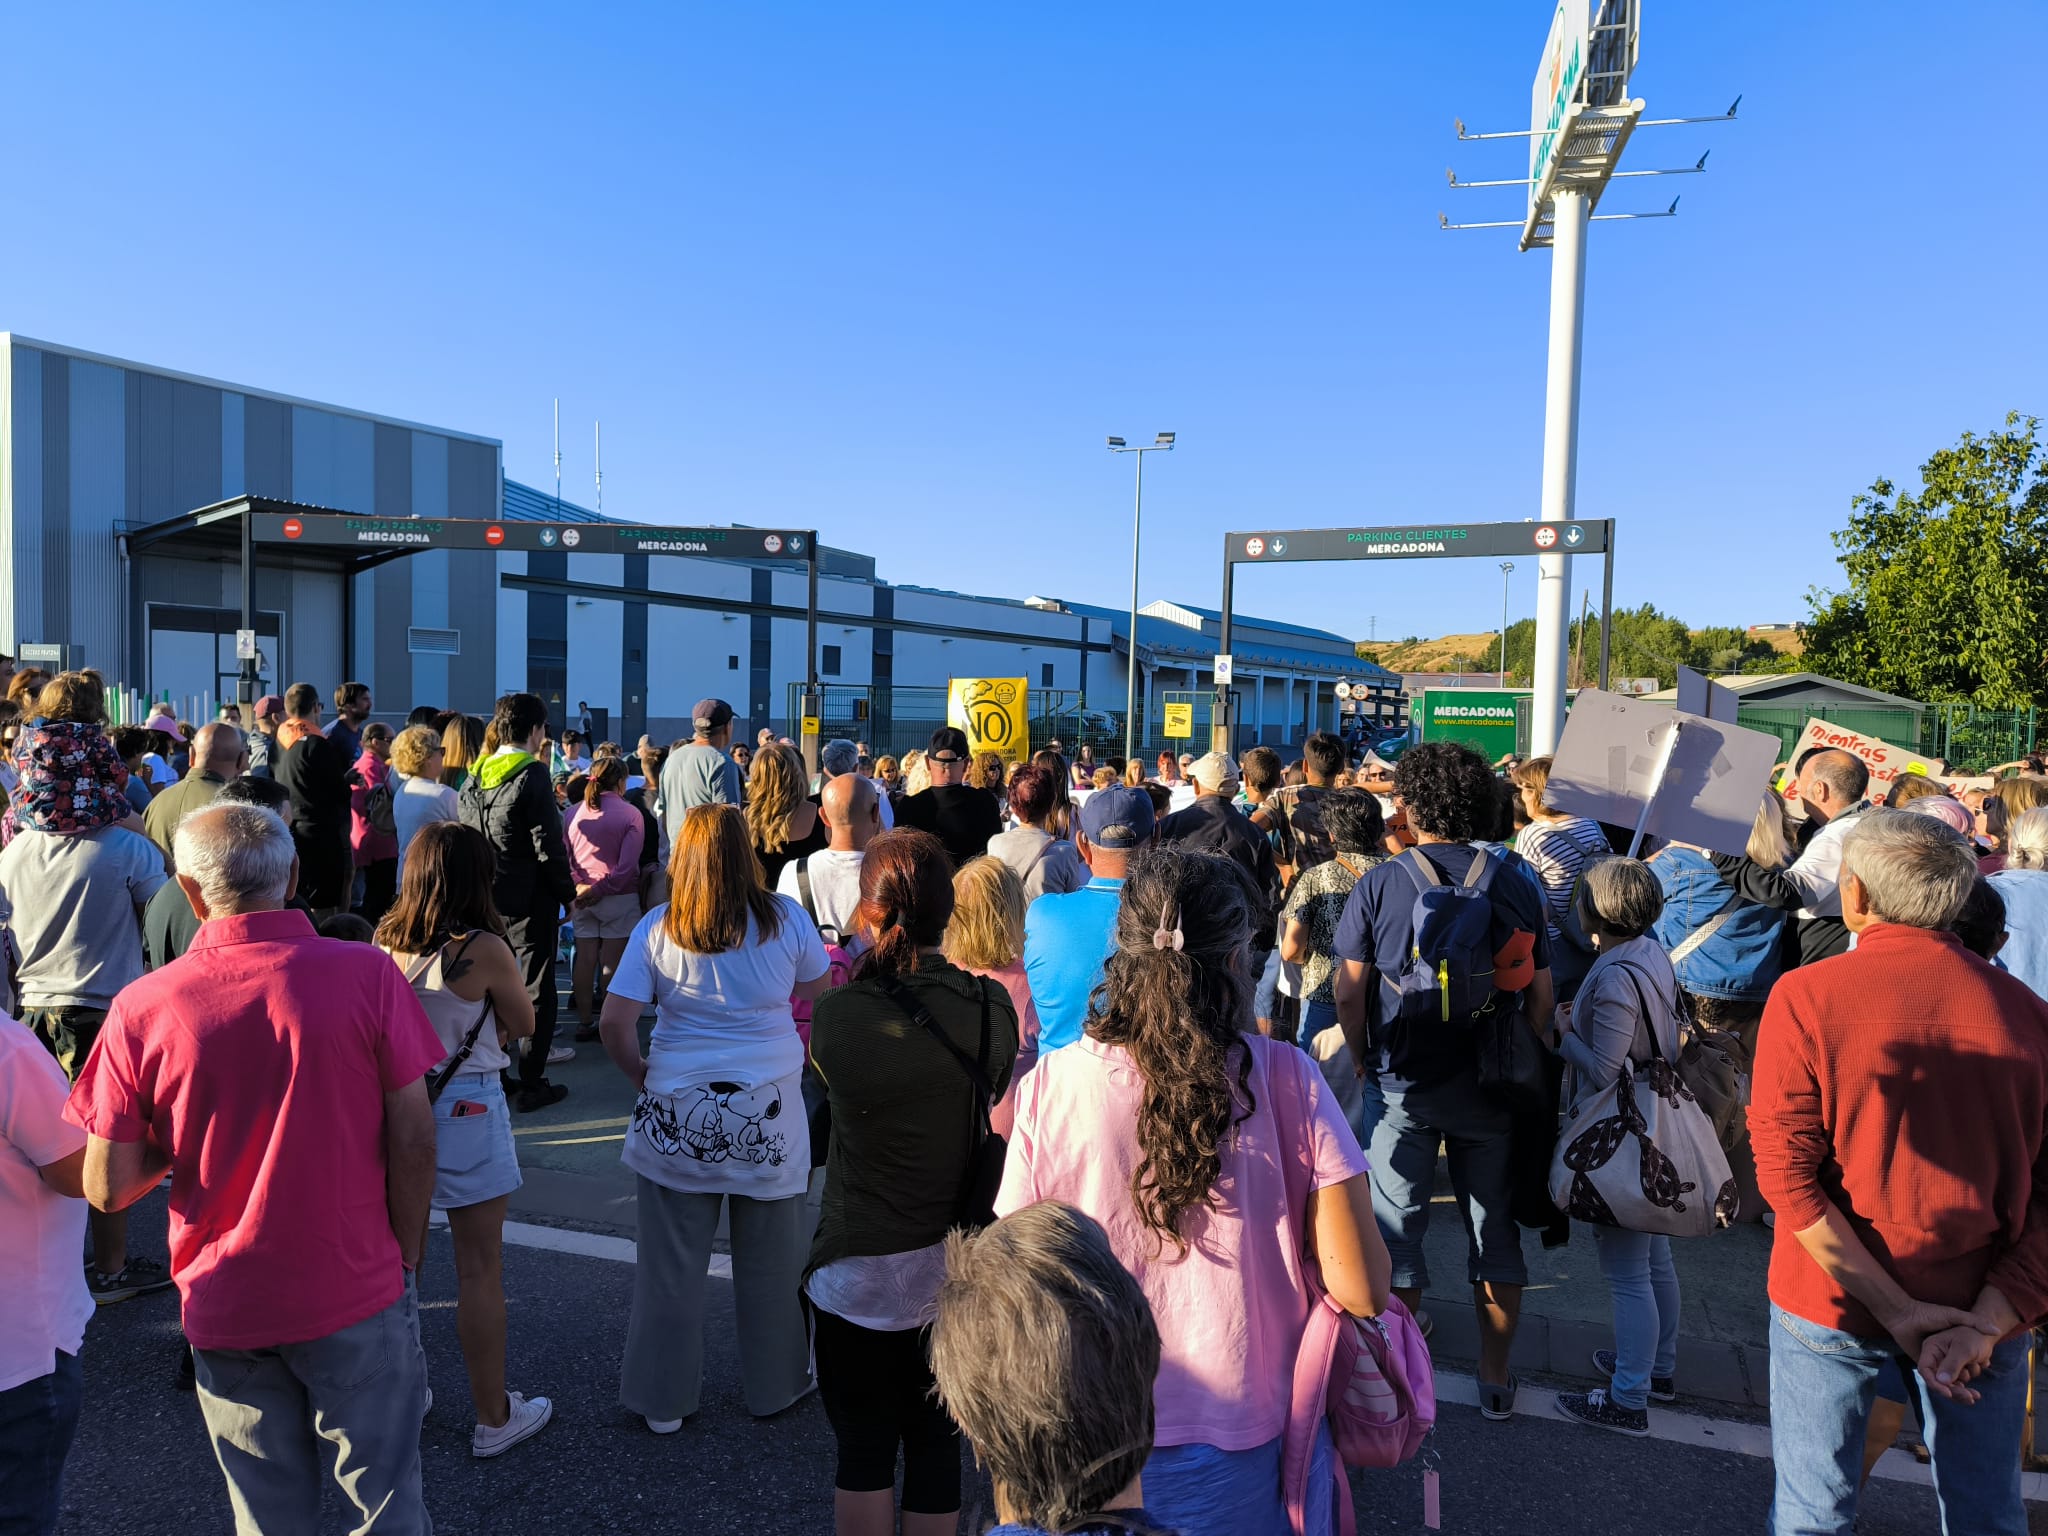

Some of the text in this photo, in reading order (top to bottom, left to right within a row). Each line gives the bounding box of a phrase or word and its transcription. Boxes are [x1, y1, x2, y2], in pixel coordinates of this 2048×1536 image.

[357, 531, 430, 543] MERCADONA
[1347, 529, 1468, 543] PARKING CLIENTES
[638, 541, 708, 552] MERCADONA
[1367, 542, 1445, 554] MERCADONA
[1433, 706, 1515, 718] MERCADONA
[1433, 718, 1515, 727] www.mercadona.es
[1809, 725, 1888, 763] mientras
